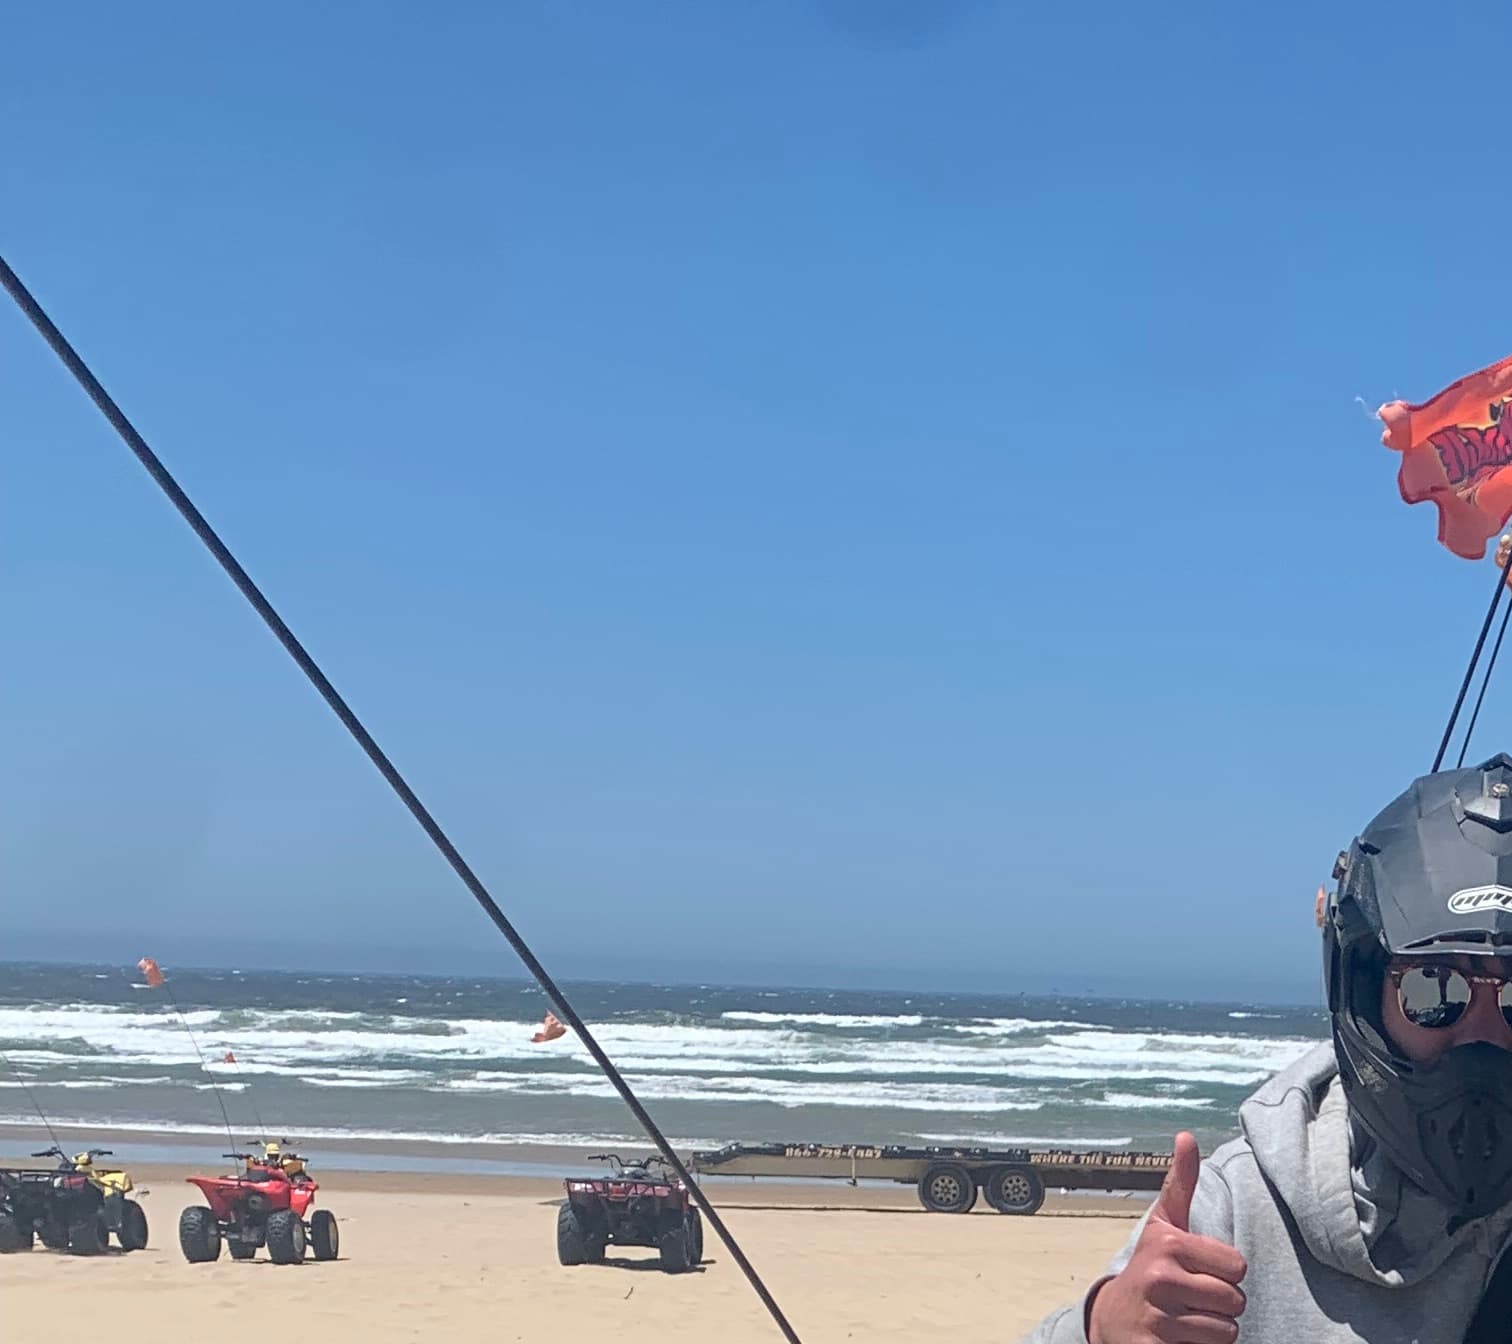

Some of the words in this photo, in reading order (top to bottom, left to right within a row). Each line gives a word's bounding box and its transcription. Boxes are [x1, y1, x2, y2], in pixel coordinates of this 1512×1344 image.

[1029, 1153, 1075, 1164] WHERE
[1079, 1154, 1102, 1166] THE
[1104, 1155, 1132, 1166] FUN
